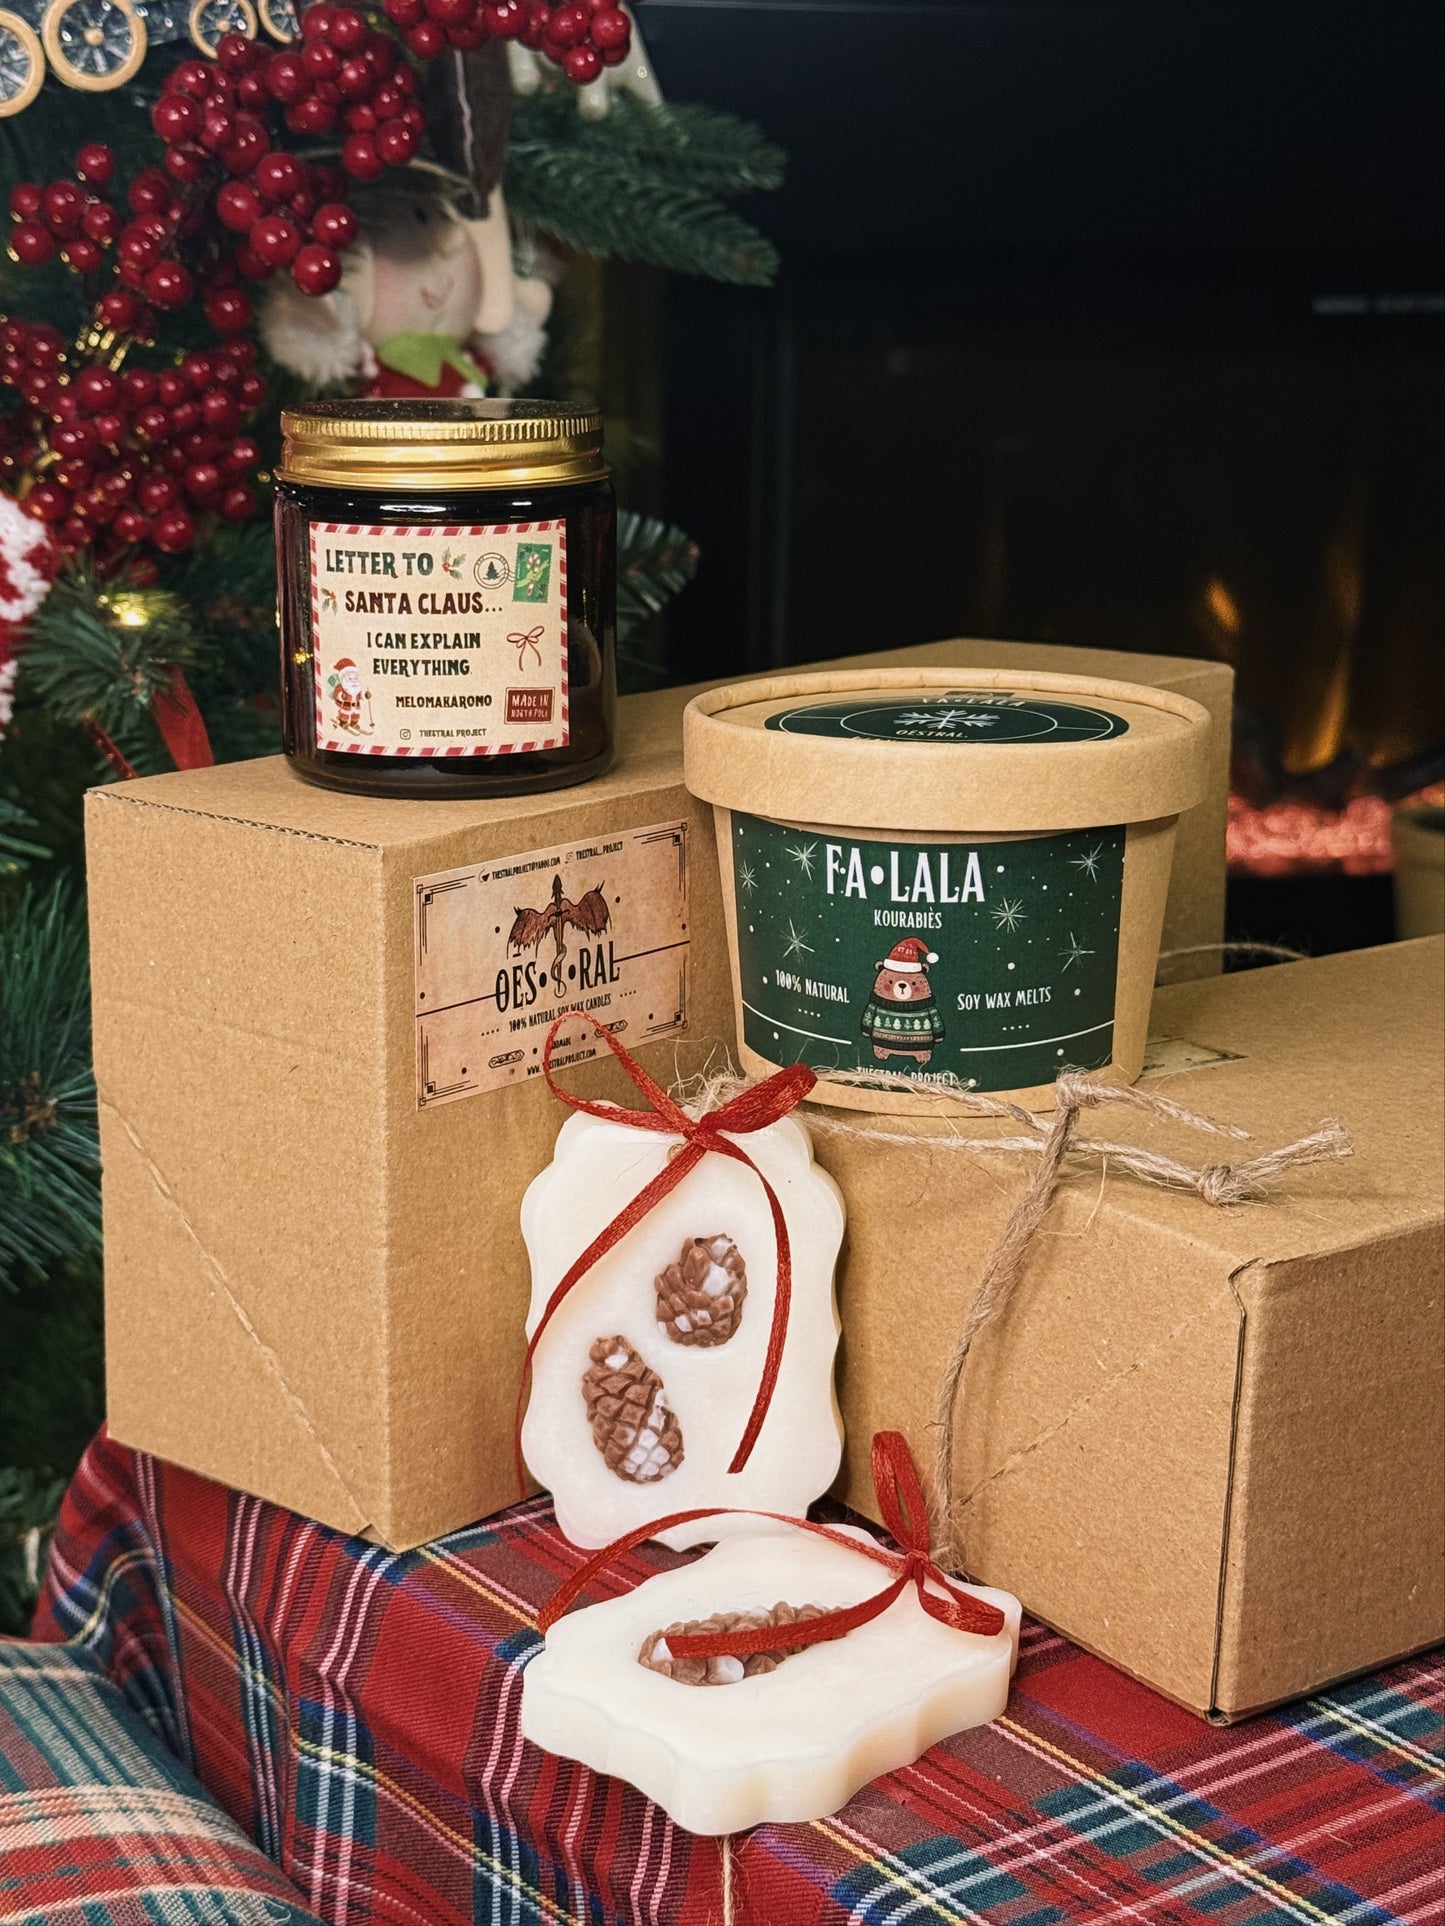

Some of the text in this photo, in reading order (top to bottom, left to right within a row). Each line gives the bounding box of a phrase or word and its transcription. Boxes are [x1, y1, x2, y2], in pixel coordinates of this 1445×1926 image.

[326, 549, 434, 578] LETTER TO
[345, 590, 503, 615] SANTA CLAUS...
[367, 632, 481, 649] I CAN EXPLAIN
[373, 658, 470, 677] EVERYTHING
[512, 694, 549, 707] MADE IN
[419, 728, 487, 738] THESTRAL PROJECT
[775, 969, 850, 1004] 100% NATURAL
[957, 986, 1052, 1011] SOY WAX MELTS
[509, 1018, 527, 1033] 100%
[528, 1009, 556, 1027] NATURAL
[557, 1004, 570, 1018] SOY
[585, 992, 612, 1011] CANDLES
